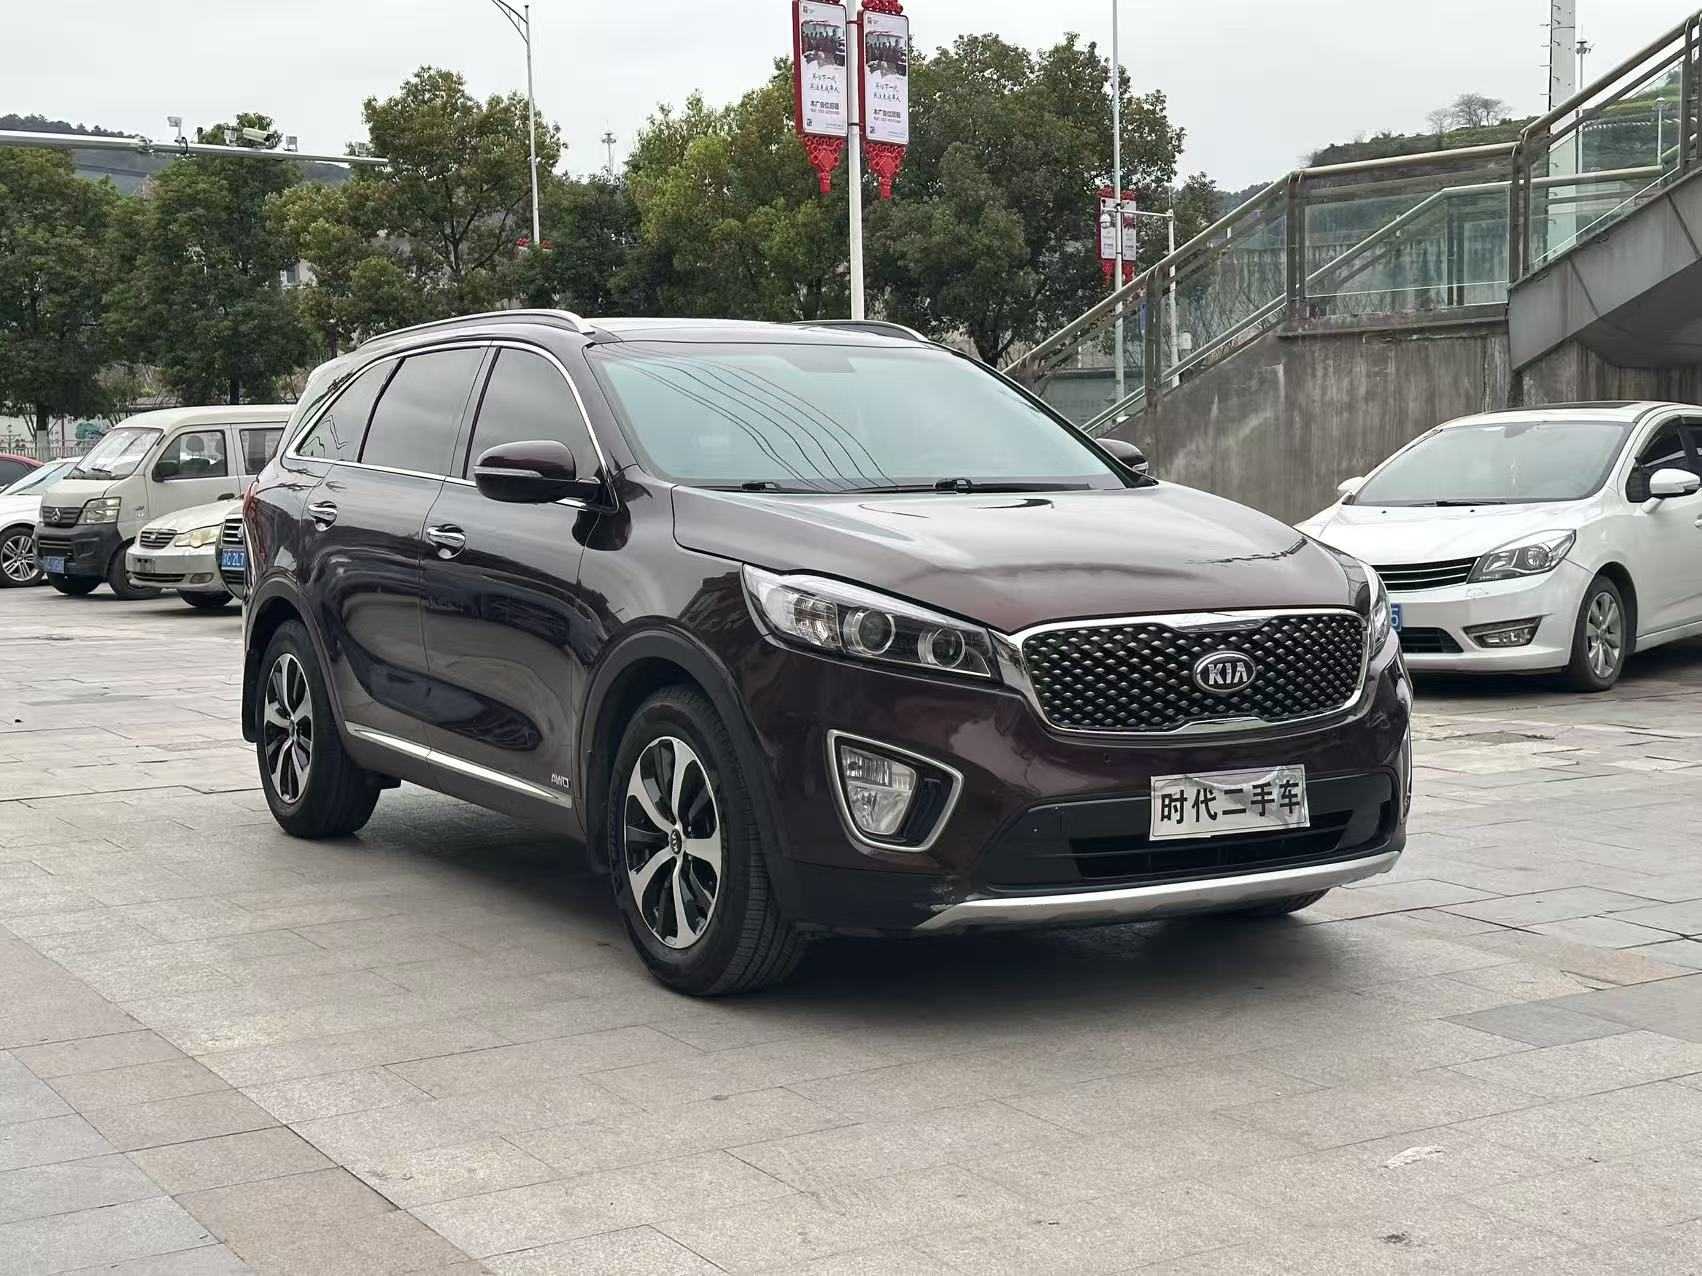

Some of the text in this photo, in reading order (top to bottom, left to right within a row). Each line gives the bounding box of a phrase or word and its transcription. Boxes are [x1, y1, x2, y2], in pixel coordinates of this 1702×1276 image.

[1208, 662, 1248, 685] KIA
[1160, 780, 1300, 824] 时代二手车
